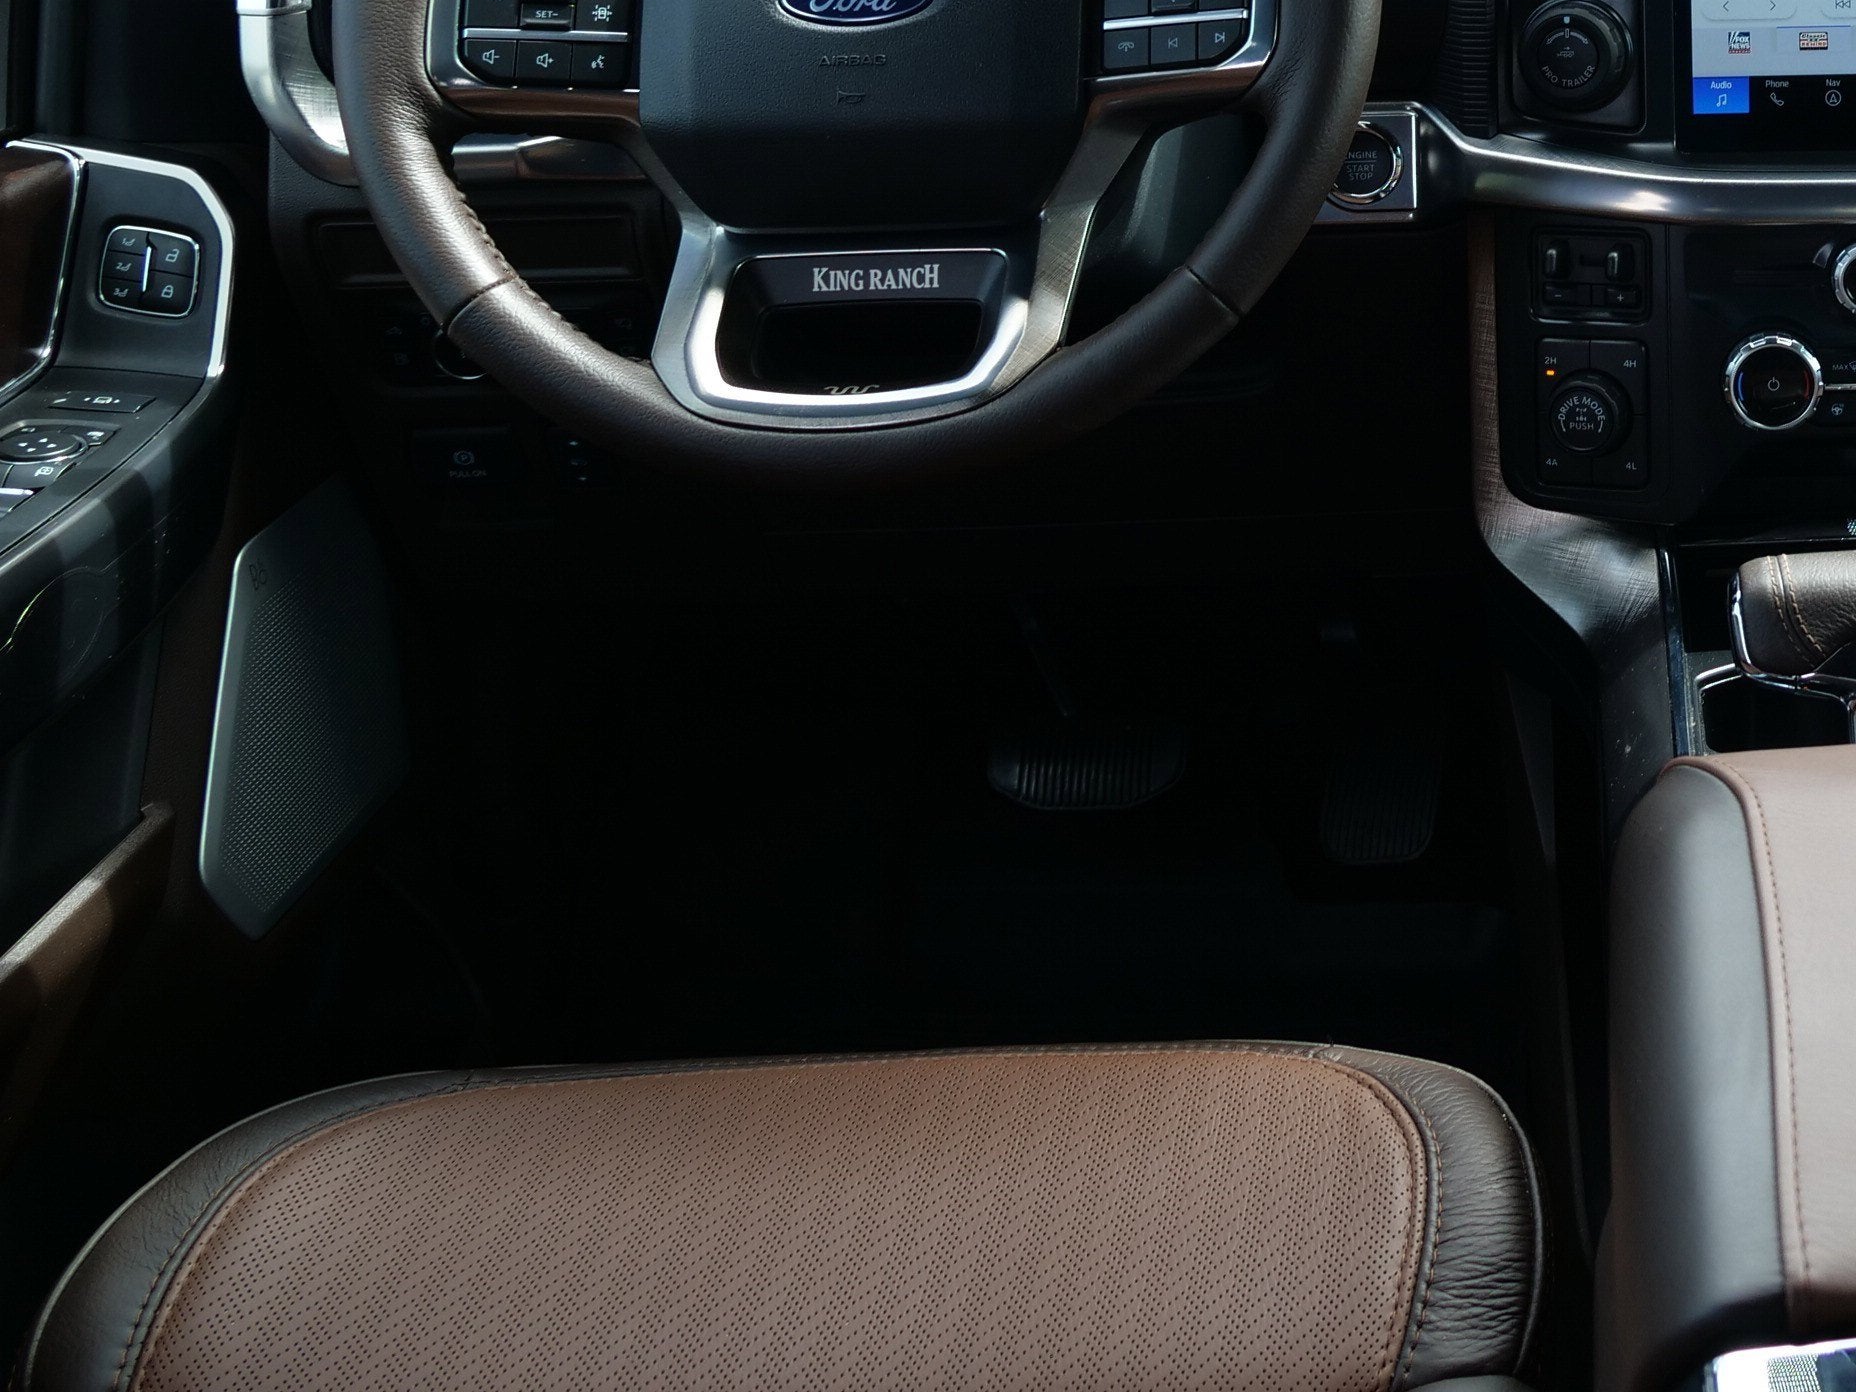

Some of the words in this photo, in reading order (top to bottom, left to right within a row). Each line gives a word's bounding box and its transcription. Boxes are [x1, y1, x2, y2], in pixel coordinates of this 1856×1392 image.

[819, 54, 887, 67] AIRBAG
[1541, 64, 1560, 86] PRO
[1561, 64, 1597, 88] TRAILER
[1710, 80, 1732, 90] Audio
[1765, 79, 1789, 88] Phone
[1825, 78, 1841, 87] Nav
[1347, 149, 1378, 160] NGINE
[1346, 163, 1375, 173] START
[1349, 172, 1374, 181] STOP
[812, 267, 864, 292] KING
[868, 263, 940, 290] RANCH
[1544, 355, 1558, 366] 2H
[1623, 359, 1637, 370] 4H
[1557, 396, 1581, 422] DRIVE
[1582, 395, 1607, 422] MODE
[1569, 422, 1595, 432] PUSH
[1545, 457, 1559, 468] 4A
[1625, 461, 1638, 472] 4L
